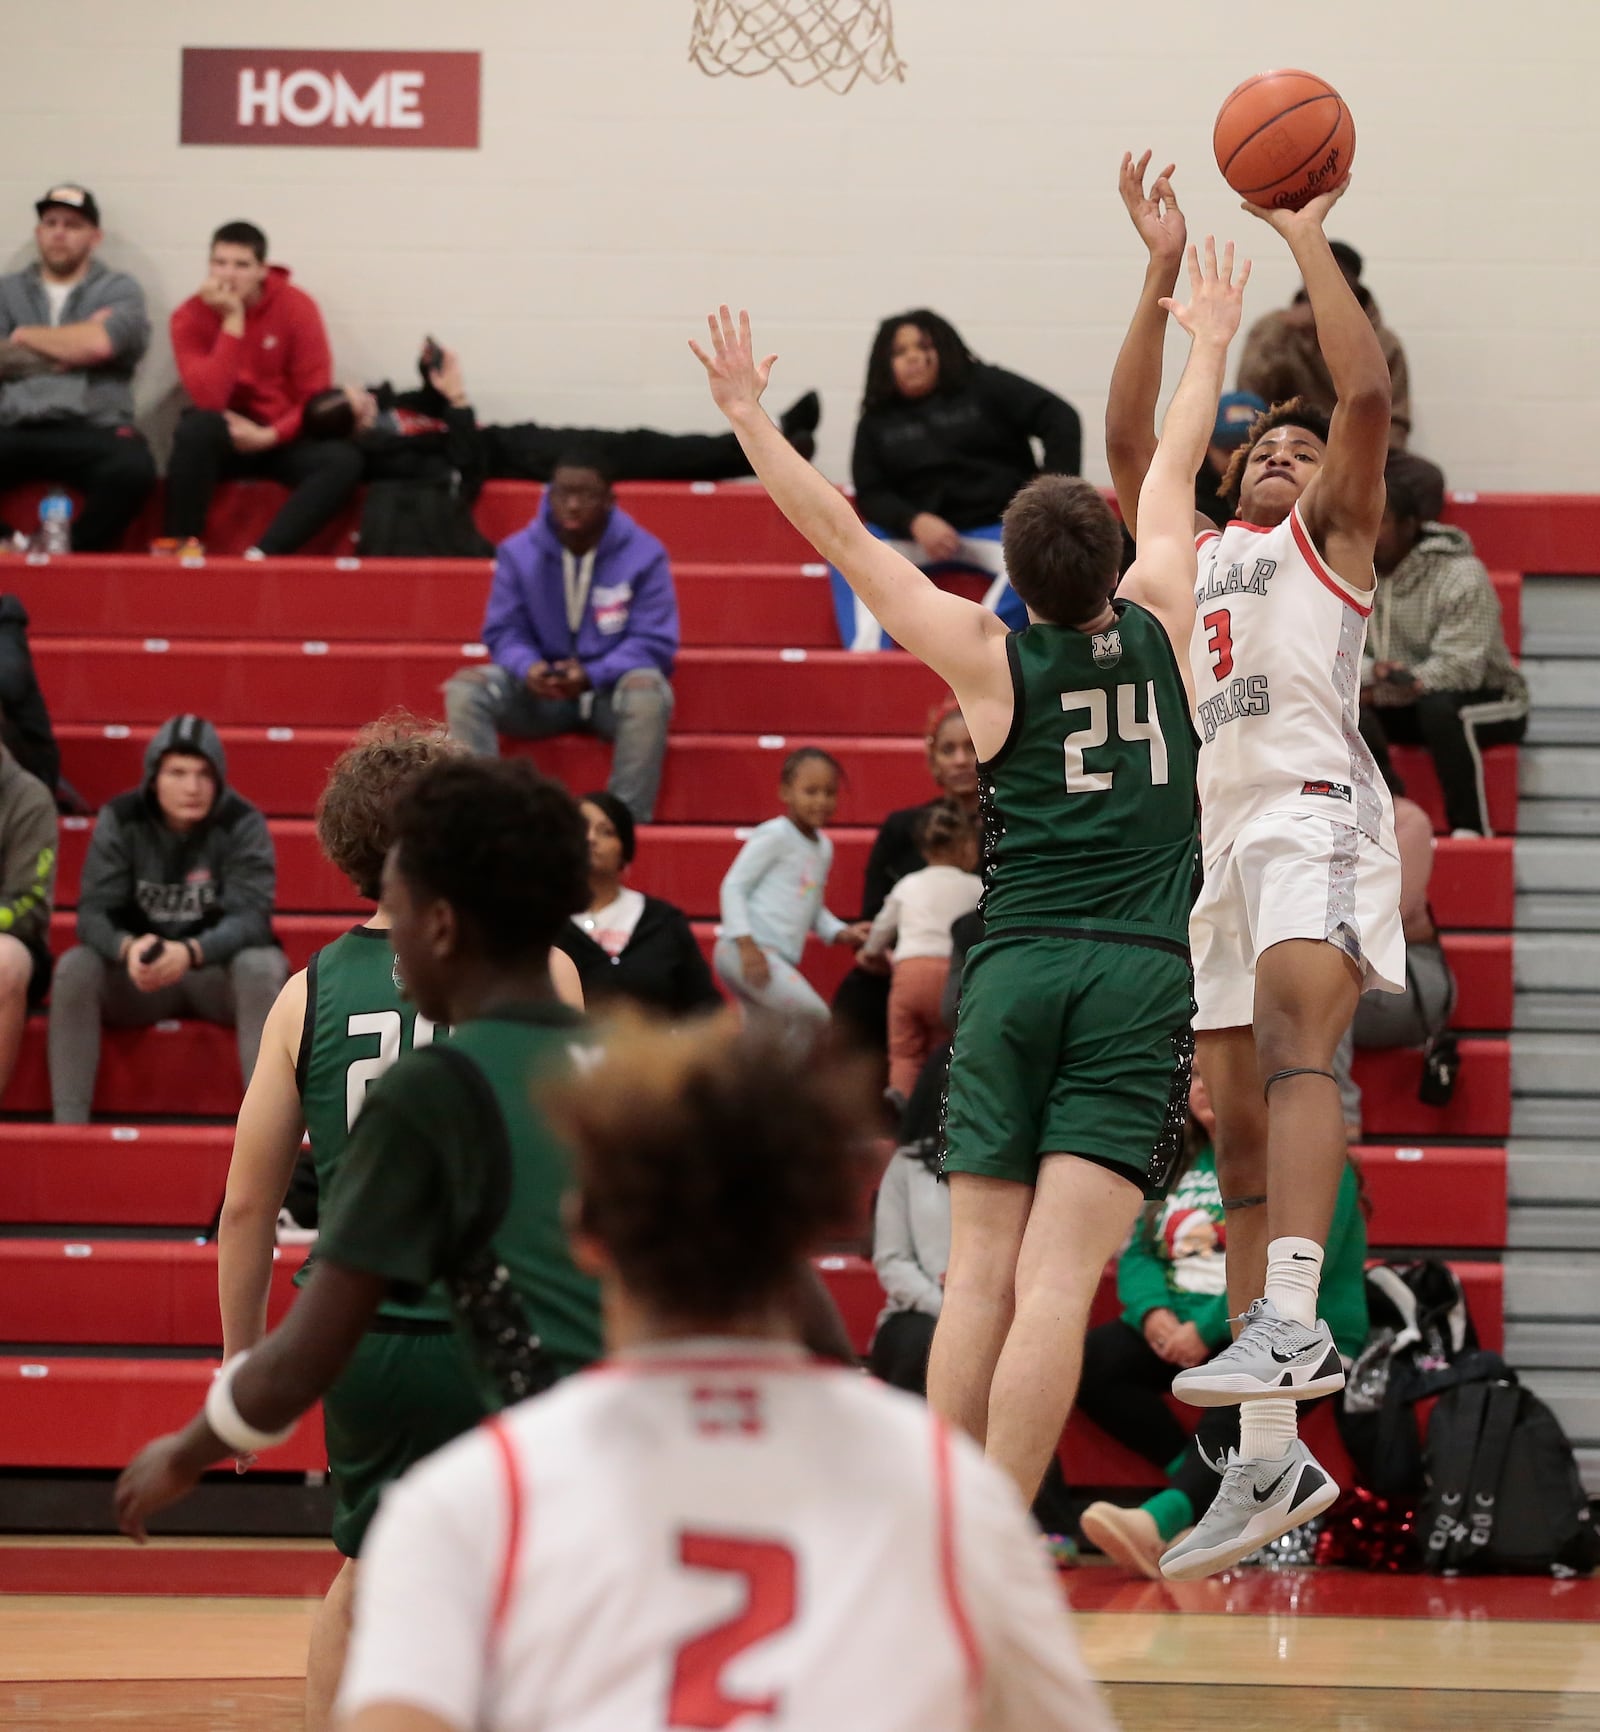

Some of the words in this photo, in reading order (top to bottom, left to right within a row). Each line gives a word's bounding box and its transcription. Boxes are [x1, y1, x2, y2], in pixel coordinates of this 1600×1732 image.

[238, 67, 425, 129] HOME
[1272, 147, 1340, 208] Rawlings
[1092, 630, 1123, 659] M
[1203, 607, 1235, 682] 3
[1060, 679, 1169, 794] 24
[665, 1530, 800, 1732] 2
